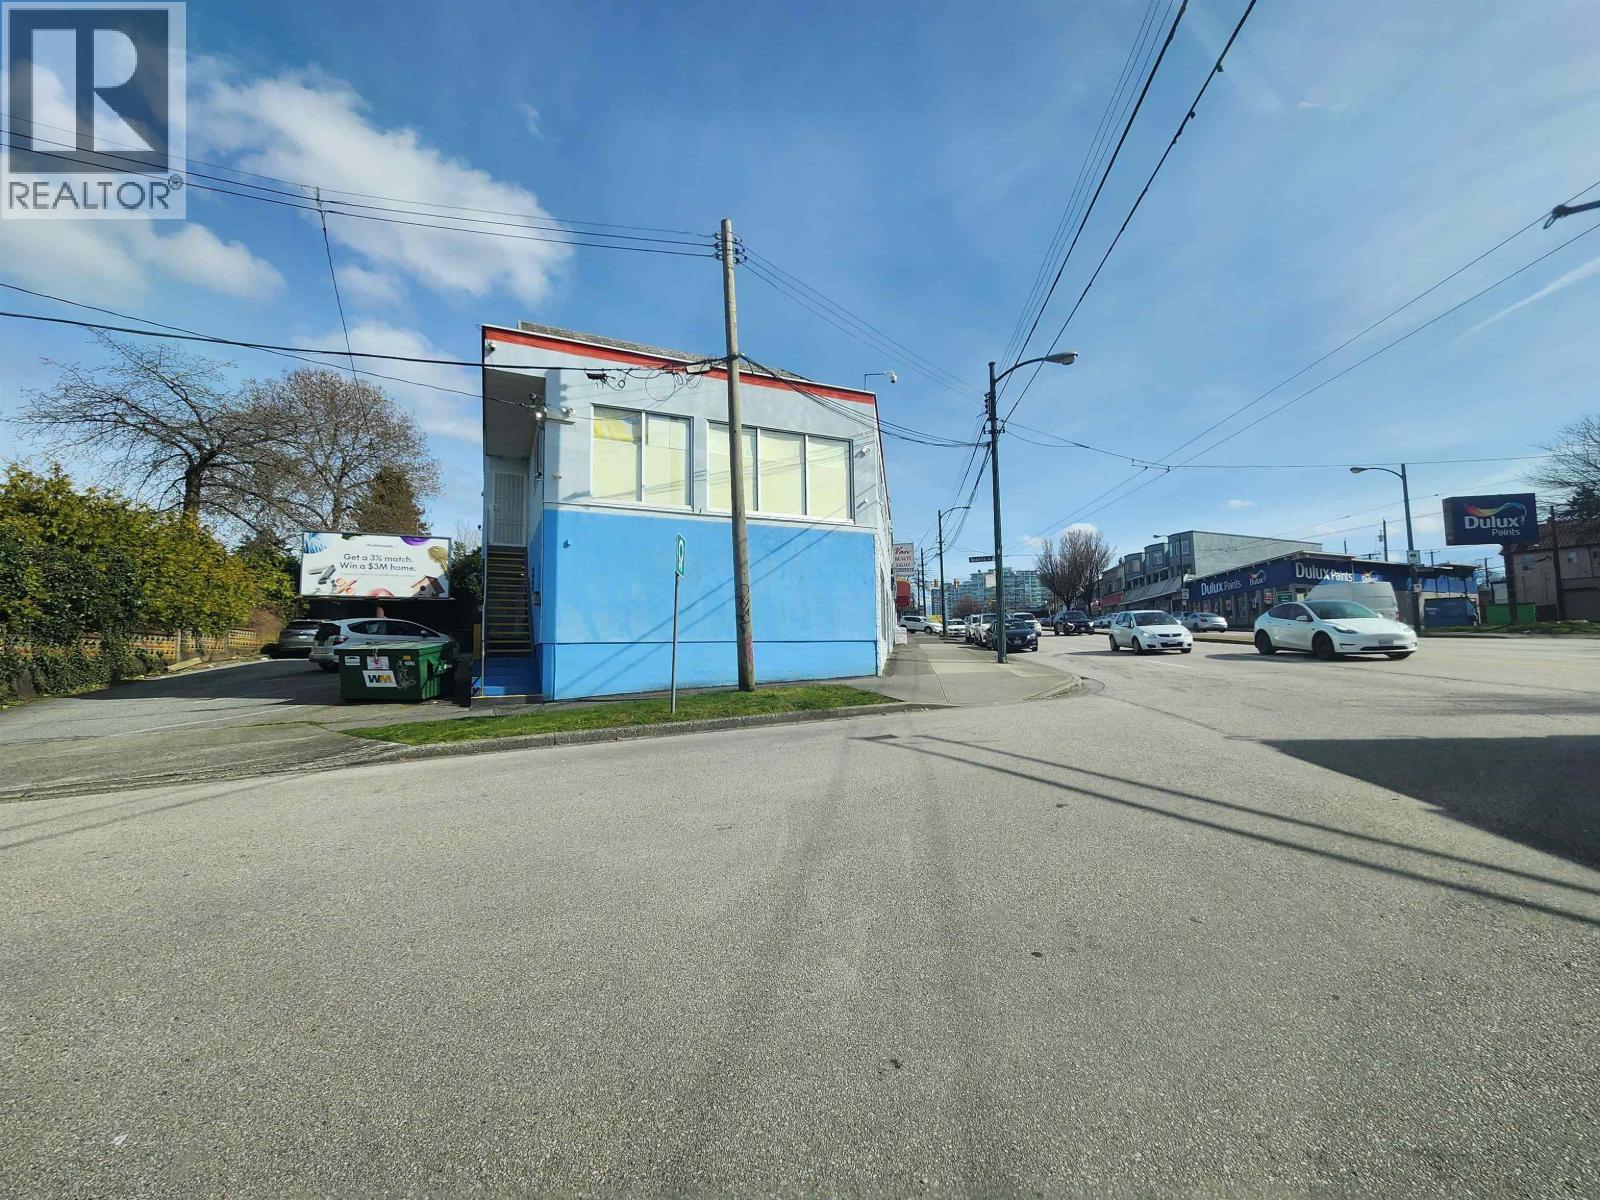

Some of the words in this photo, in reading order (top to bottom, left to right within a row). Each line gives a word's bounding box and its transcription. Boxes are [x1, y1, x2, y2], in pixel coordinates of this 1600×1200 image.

[1464, 516, 1519, 529] Dulux
[1491, 528, 1520, 537] Paints
[343, 553, 360, 561] Get
[370, 554, 383, 562] 3%
[384, 555, 414, 563] match.
[368, 562, 388, 571] $3M
[390, 564, 417, 572] home.
[1295, 562, 1331, 580] Dulux
[1331, 570, 1353, 582] Paints
[1201, 581, 1224, 597] Dulux
[1224, 579, 1242, 591] Paints
[367, 674, 391, 683] WM
